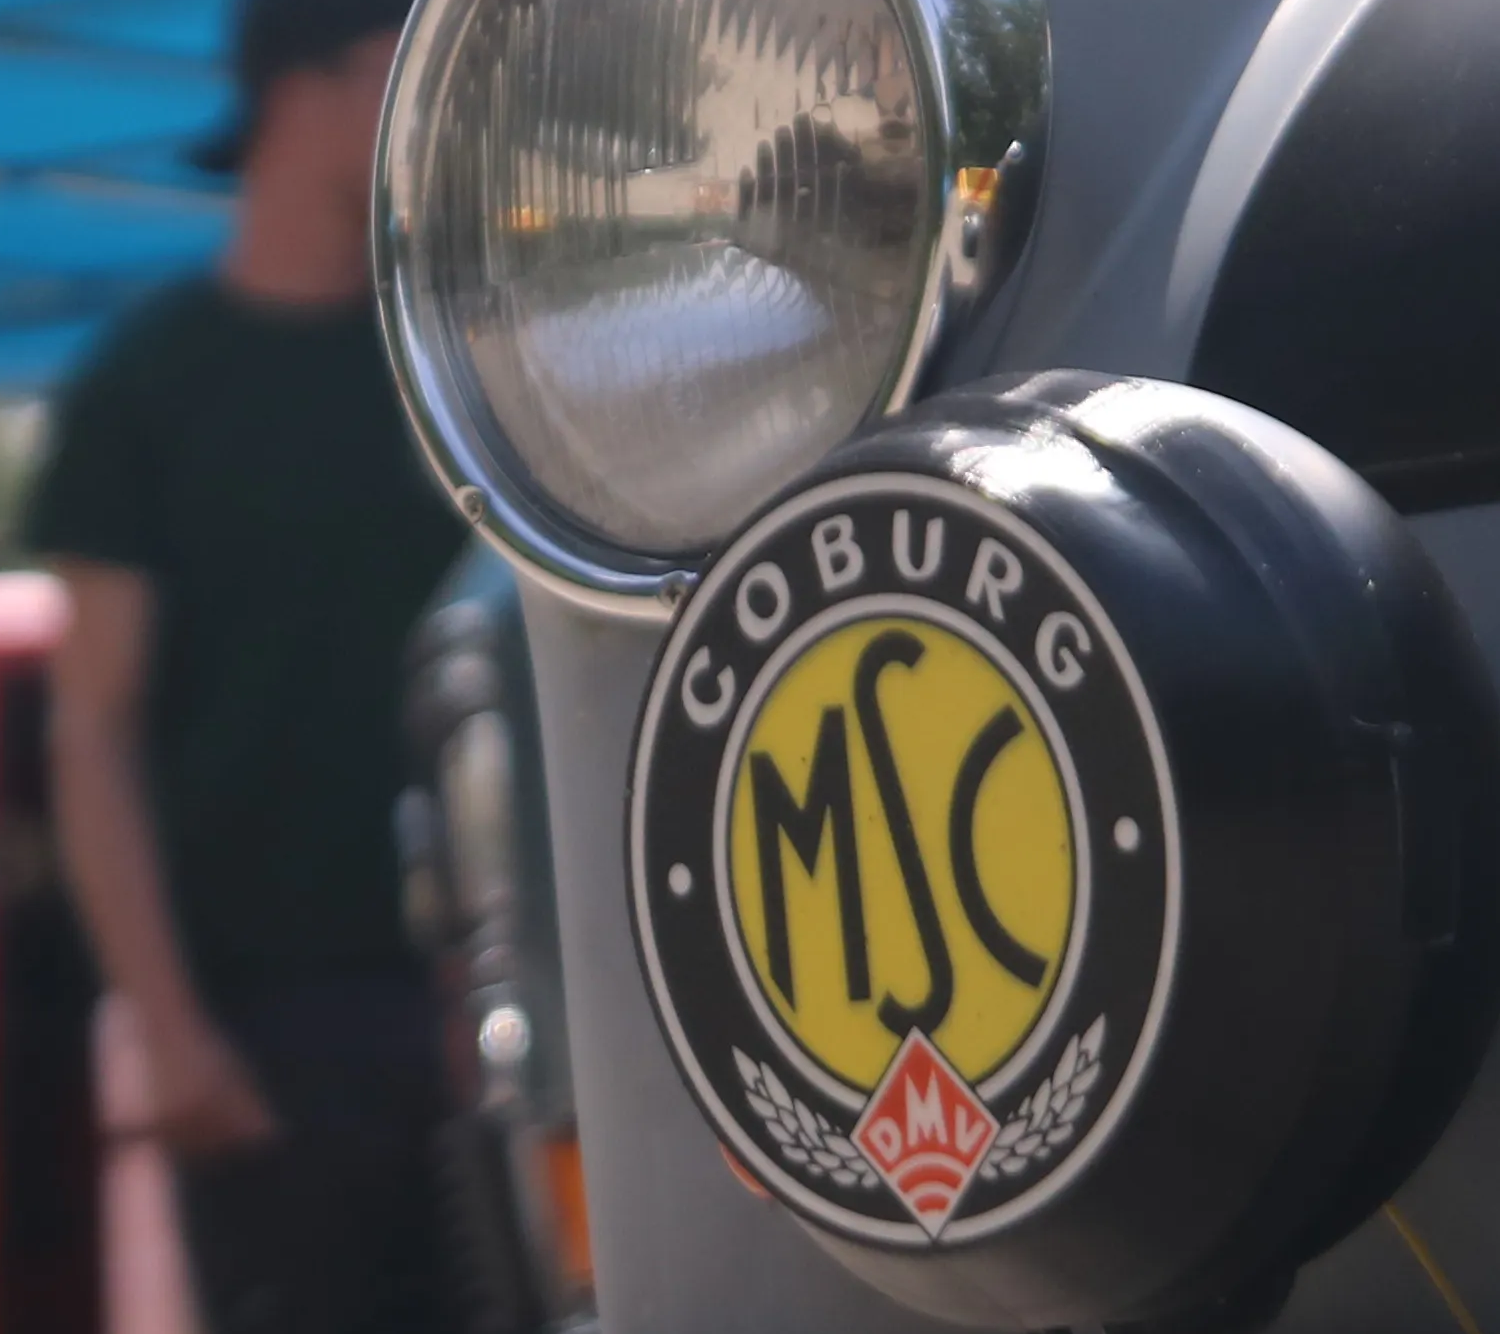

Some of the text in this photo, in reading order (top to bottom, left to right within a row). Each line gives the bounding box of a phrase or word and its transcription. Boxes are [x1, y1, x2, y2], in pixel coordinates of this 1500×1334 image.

[680, 508, 1093, 729] COBURG
[748, 629, 1048, 1033] MSC
[872, 1067, 988, 1155] DMV
